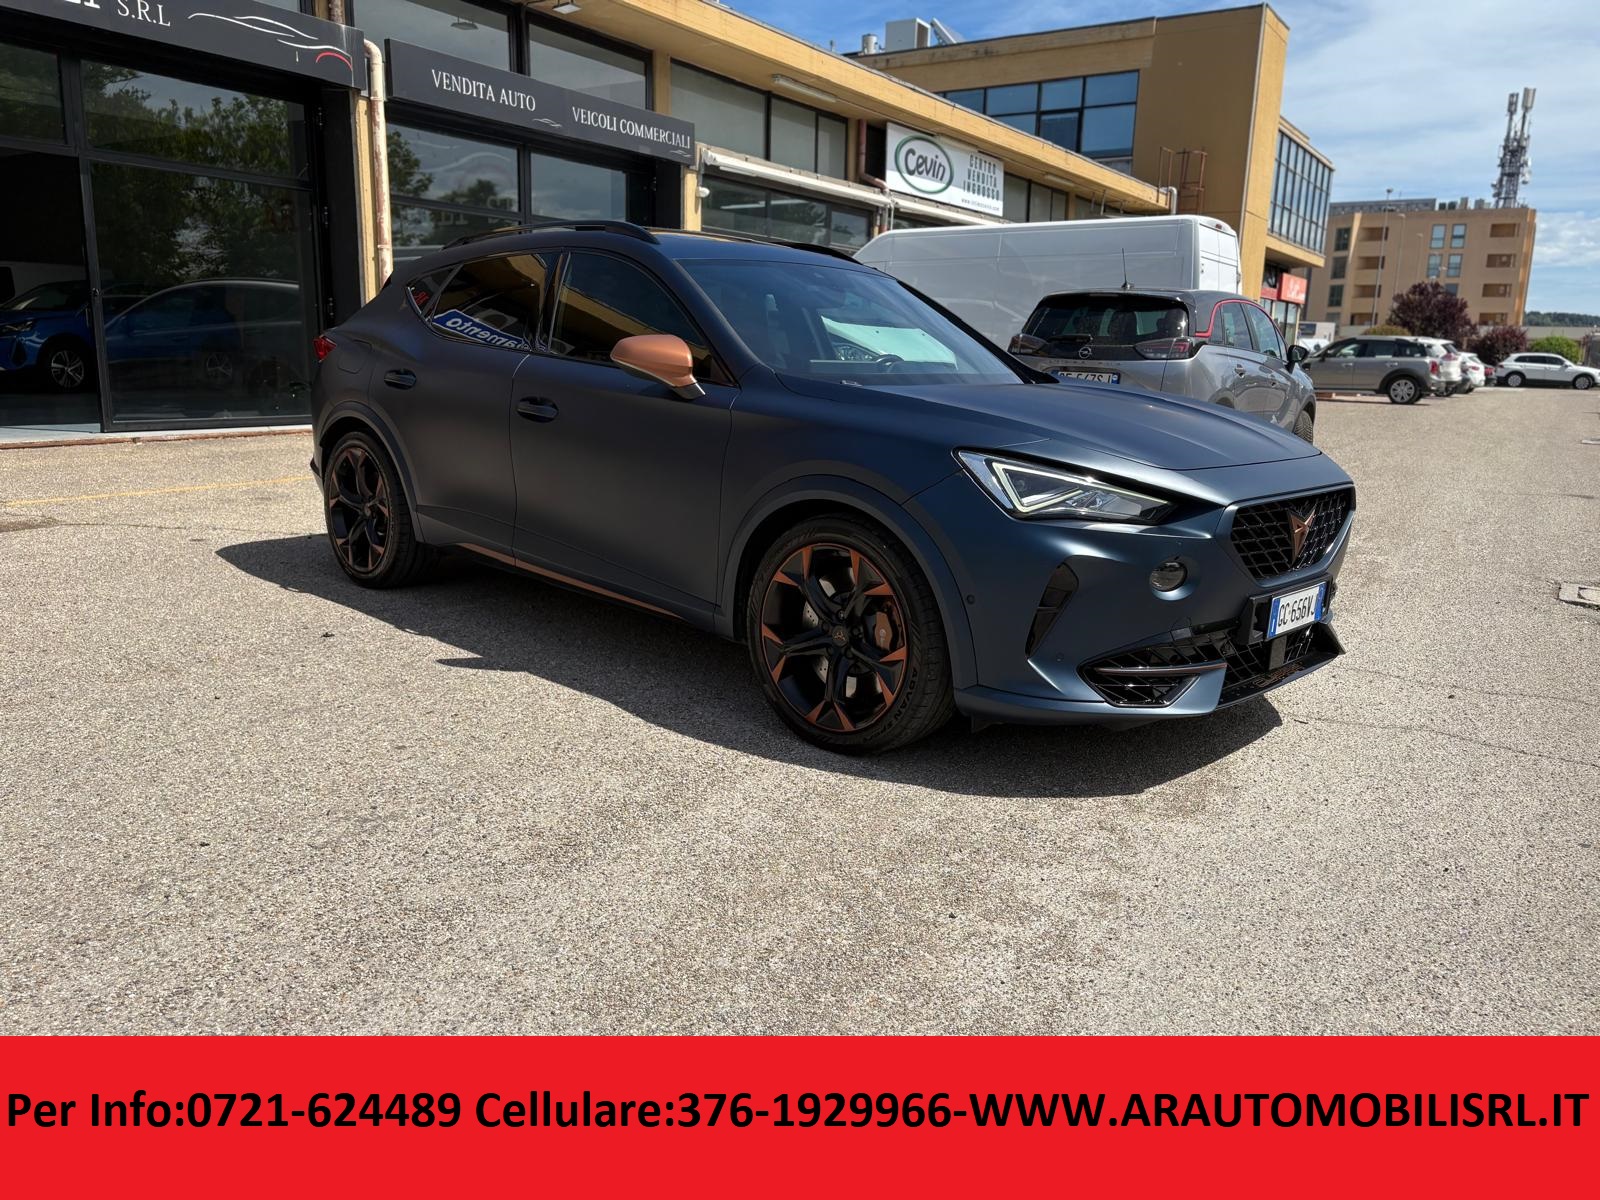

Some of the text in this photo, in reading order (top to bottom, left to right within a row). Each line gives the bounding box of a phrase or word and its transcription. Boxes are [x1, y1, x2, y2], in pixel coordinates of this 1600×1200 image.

[116, 0, 172, 27] S.R.L
[431, 68, 536, 112] VENDITA AUTO
[572, 106, 691, 150] VEICOLI COMMERCIALI
[905, 148, 946, 181] Cevin
[967, 168, 996, 188] VENDITA
[969, 154, 995, 175] CENTRO
[963, 180, 1000, 201] INGROSSO
